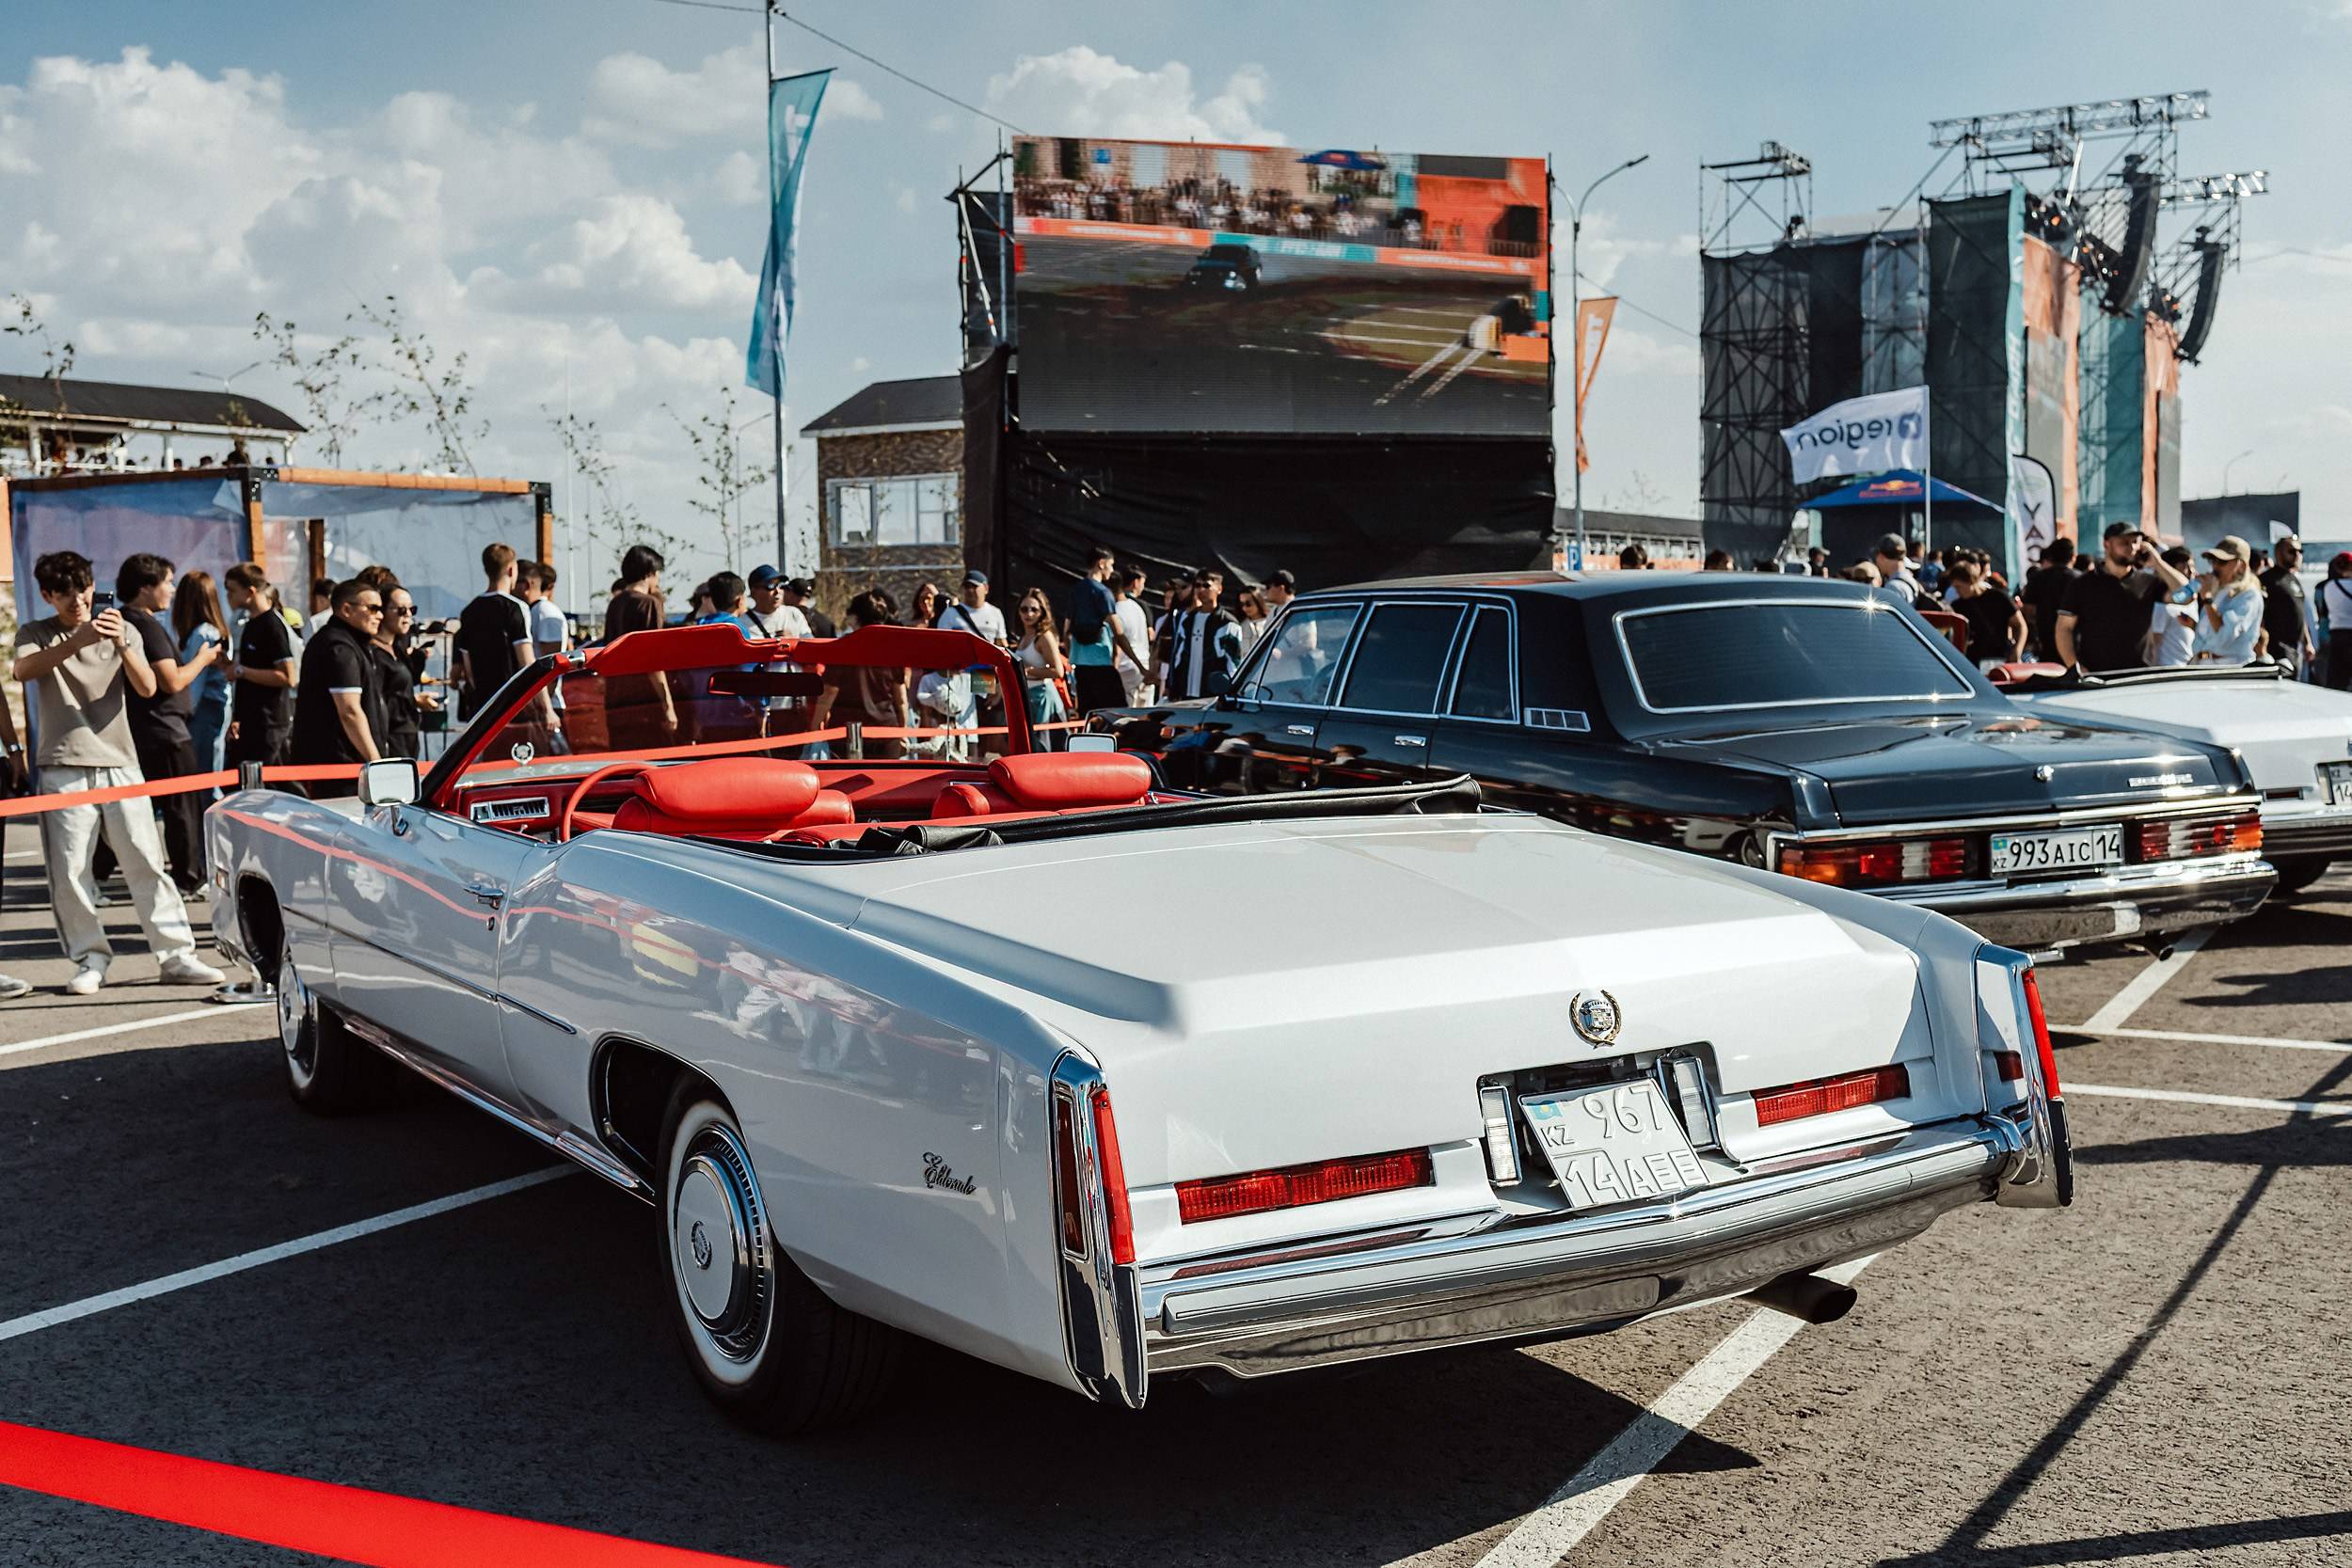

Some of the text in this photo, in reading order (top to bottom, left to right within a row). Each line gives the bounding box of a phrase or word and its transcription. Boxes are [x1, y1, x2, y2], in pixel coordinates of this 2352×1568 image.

[2096, 833, 2121, 860] 14
[1582, 1084, 1663, 1138] 967
[1540, 1124, 1575, 1147] KZ
